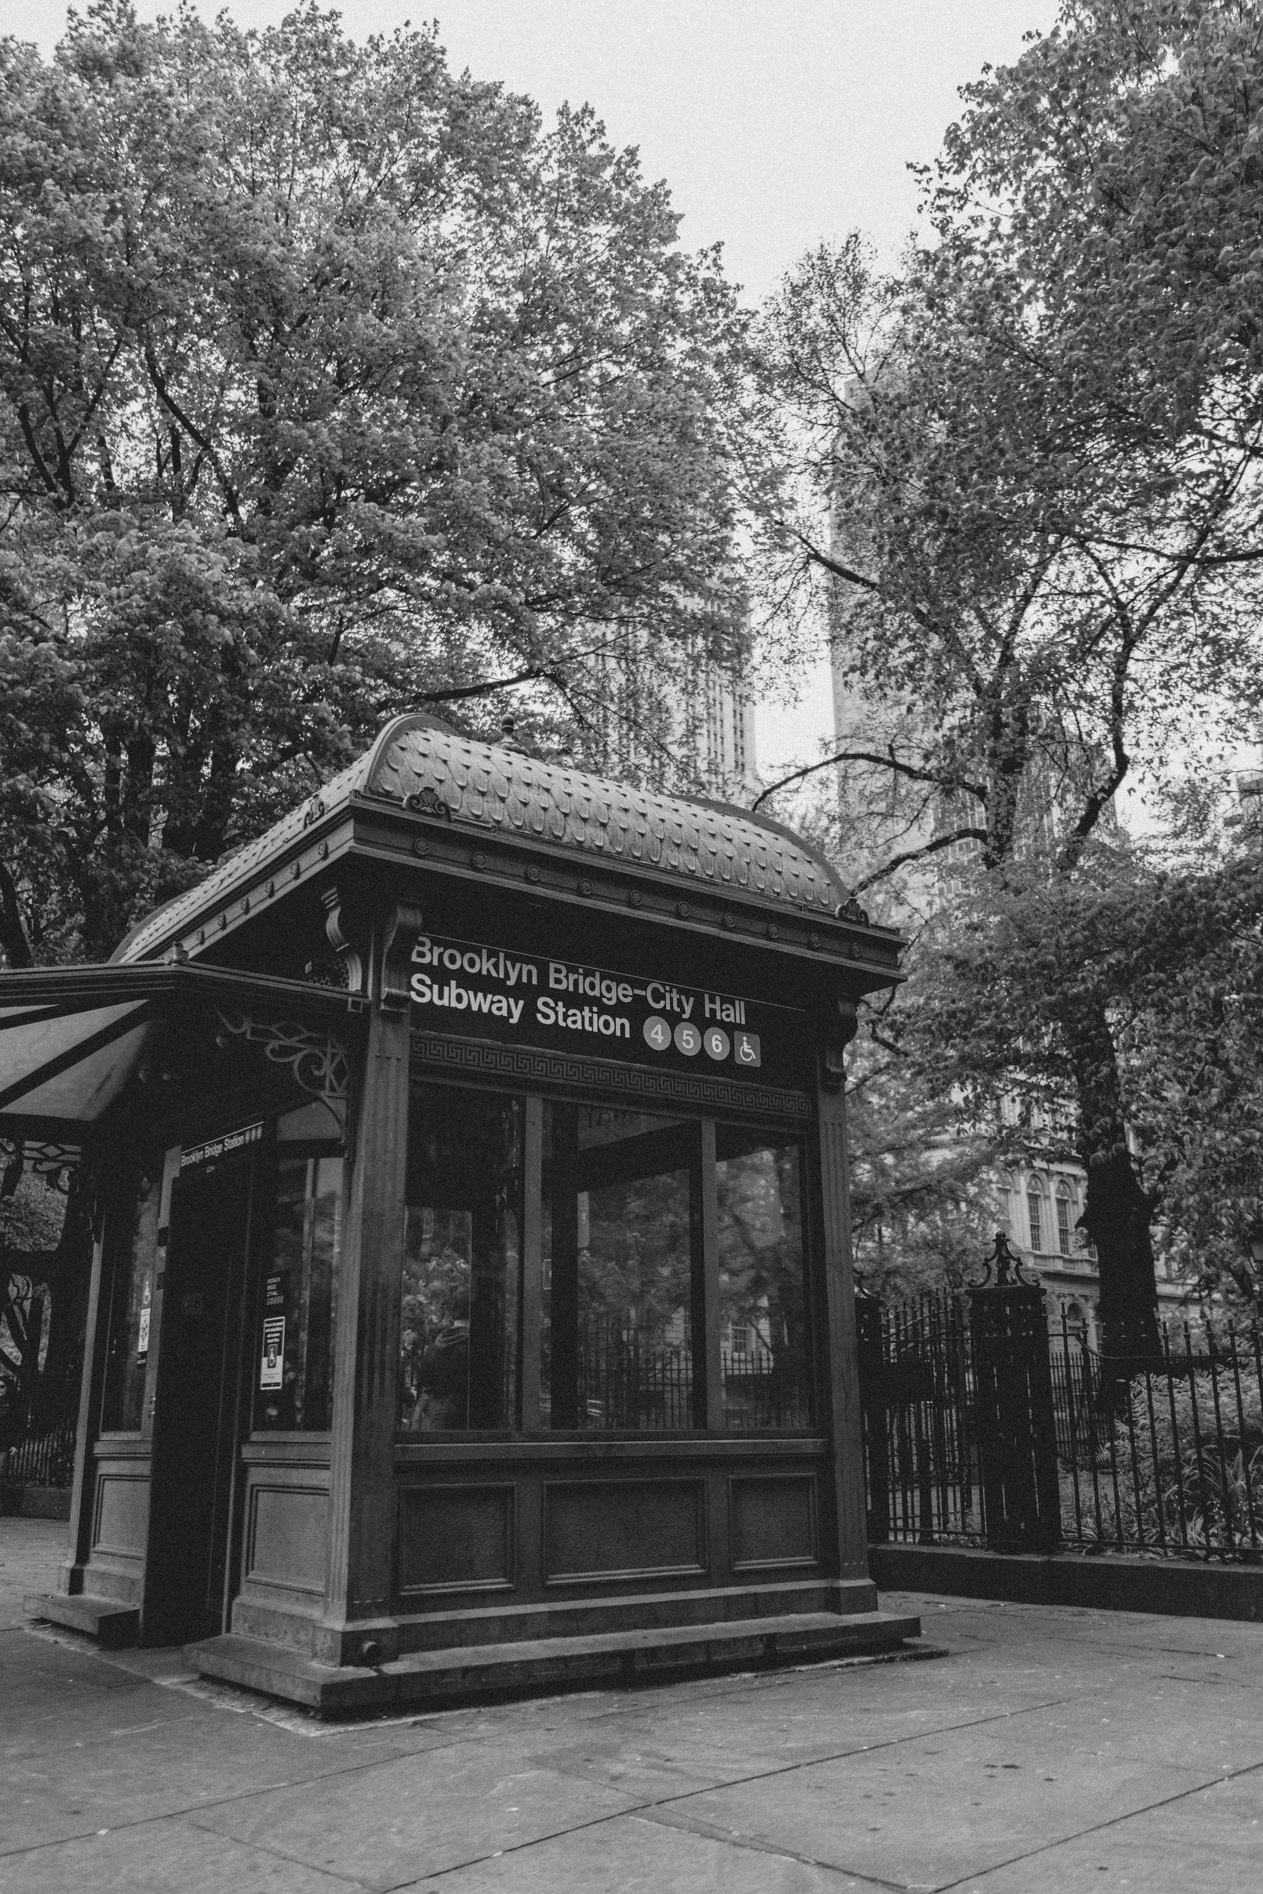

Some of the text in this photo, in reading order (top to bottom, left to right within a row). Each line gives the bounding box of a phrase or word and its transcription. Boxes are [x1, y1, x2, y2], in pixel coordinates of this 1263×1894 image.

[410, 974, 524, 1024] Subway
[536, 996, 630, 1038] Station
[411, 936, 538, 986] Brooklyn
[704, 994, 746, 1024] Hall
[181, 1150, 204, 1167] Brooklyn
[205, 1143, 222, 1158] Bridge
[224, 1135, 244, 1151] Station
